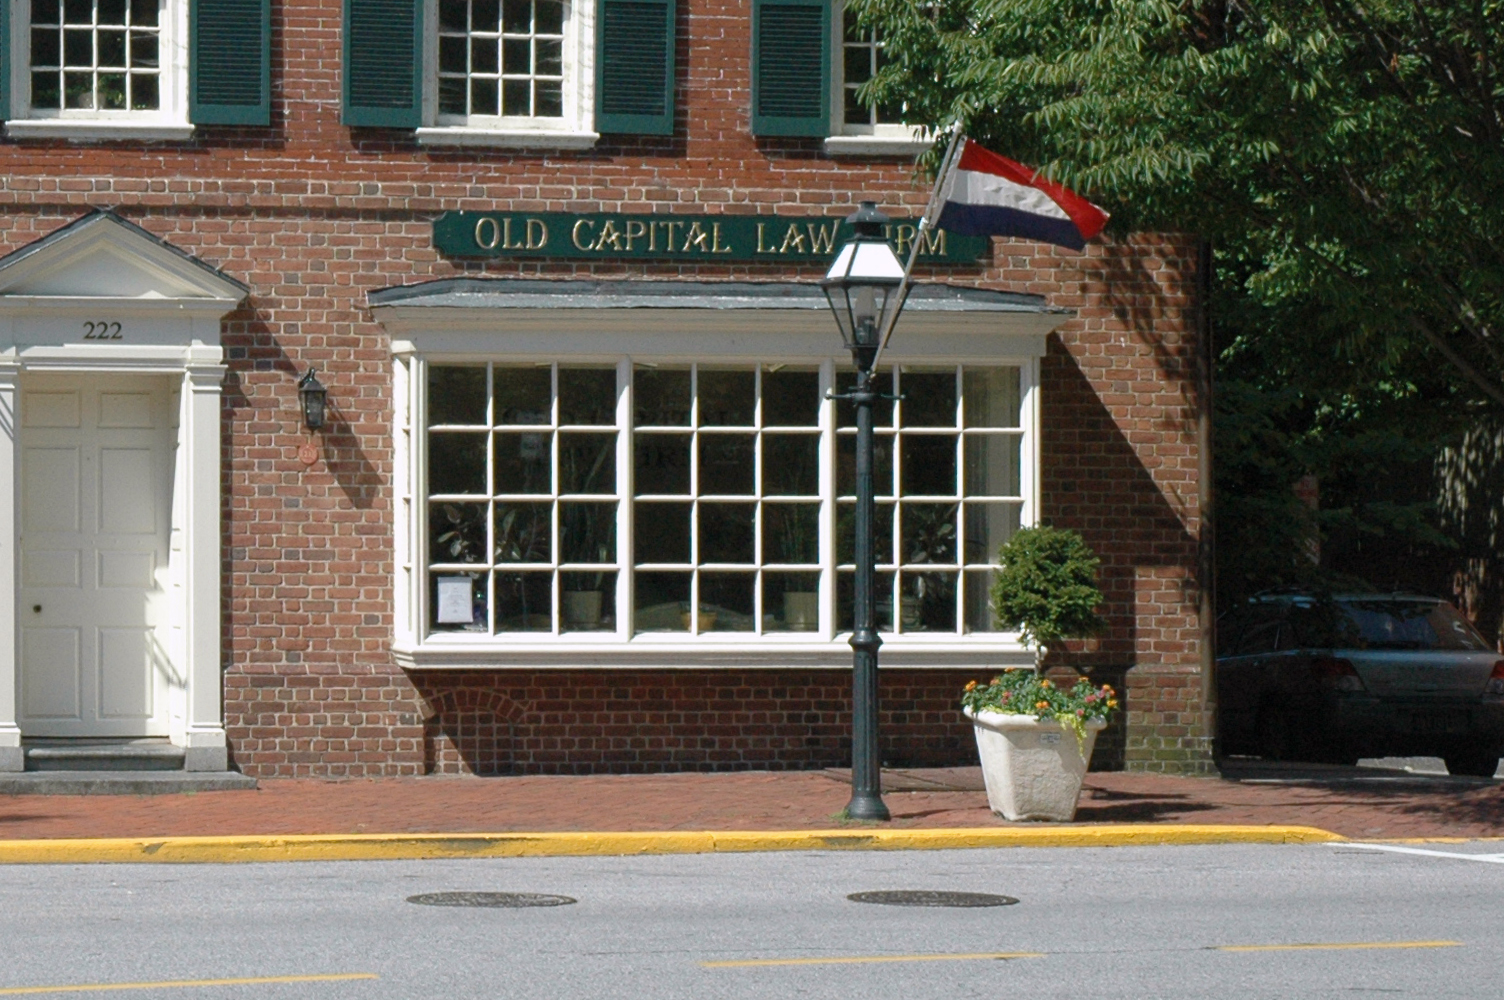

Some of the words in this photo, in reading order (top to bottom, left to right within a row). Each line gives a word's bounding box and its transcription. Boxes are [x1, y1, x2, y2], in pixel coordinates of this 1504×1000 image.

[474, 216, 549, 251] OLD
[572, 219, 733, 254] CAPITAL
[756, 219, 841, 254] LAW
[82, 321, 124, 340] 222
